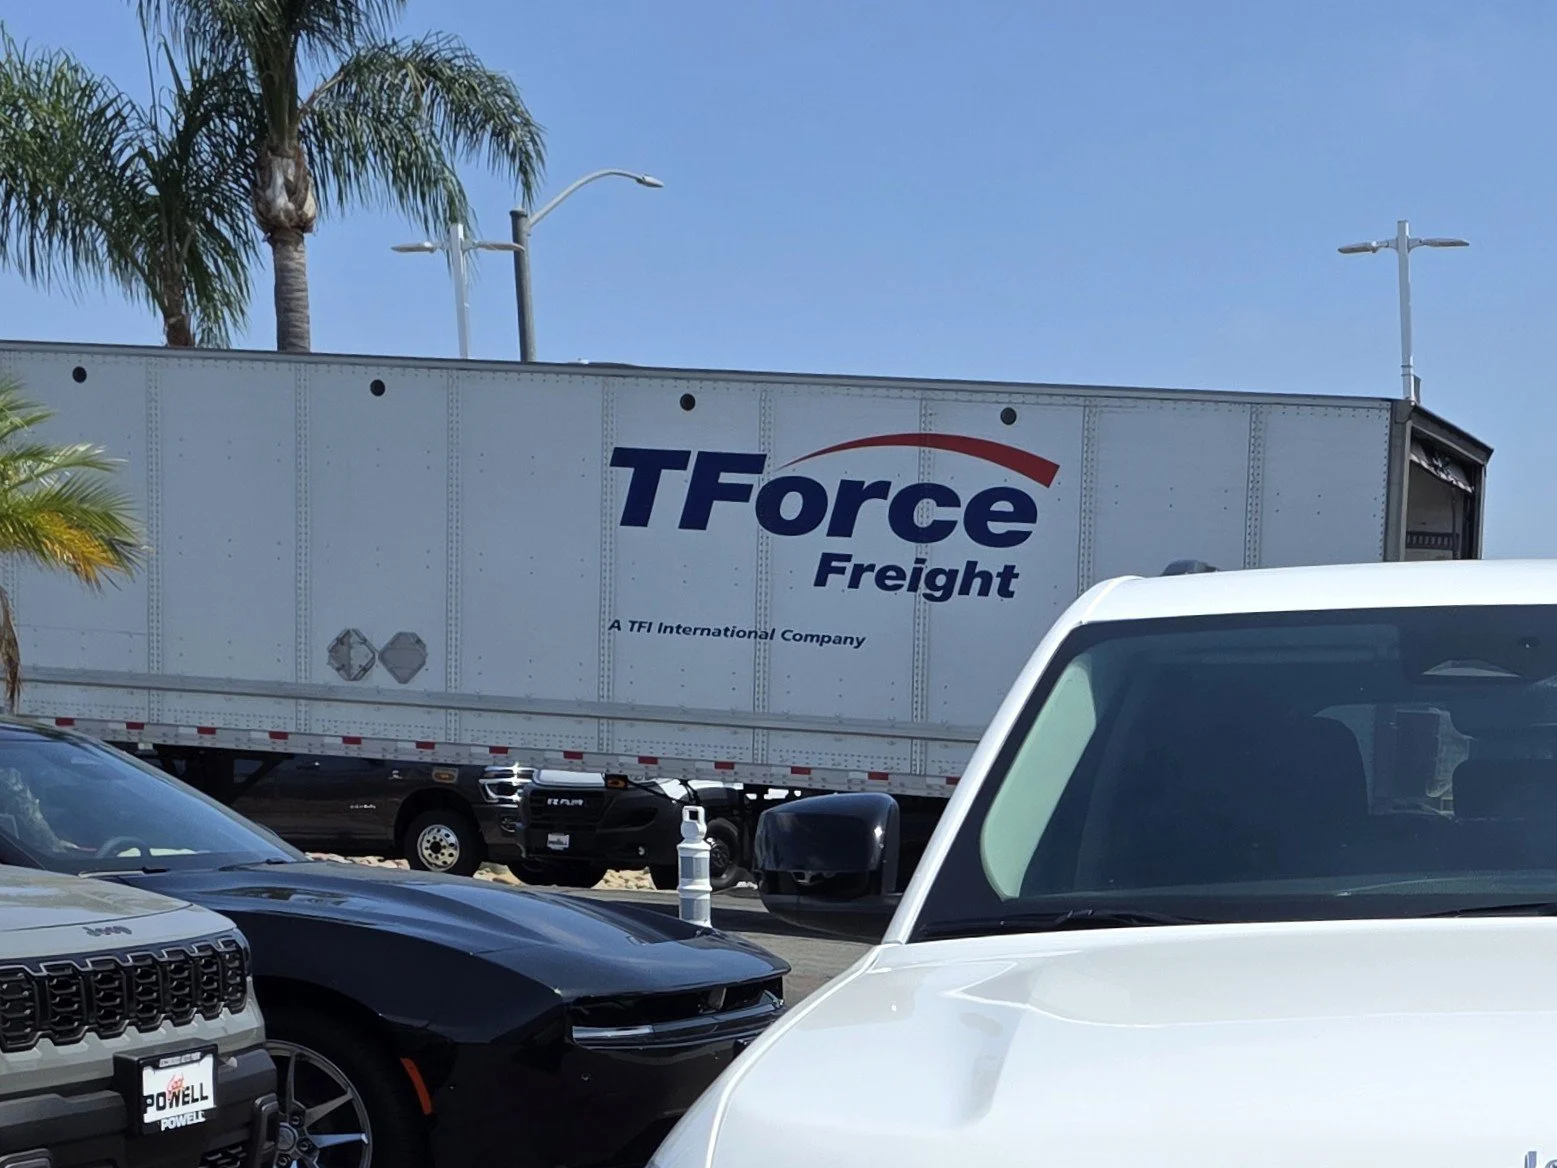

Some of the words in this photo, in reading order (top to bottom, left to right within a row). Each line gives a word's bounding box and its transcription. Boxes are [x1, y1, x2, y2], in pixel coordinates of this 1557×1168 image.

[609, 446, 1039, 549] TForce
[812, 551, 1020, 603] Freight
[608, 618, 622, 632] A
[627, 620, 653, 634] TFI
[657, 622, 776, 641] International
[780, 628, 867, 650] Company
[546, 797, 584, 807] RAM
[143, 1082, 209, 1114] POWELL
[160, 1110, 207, 1132] POWELL
